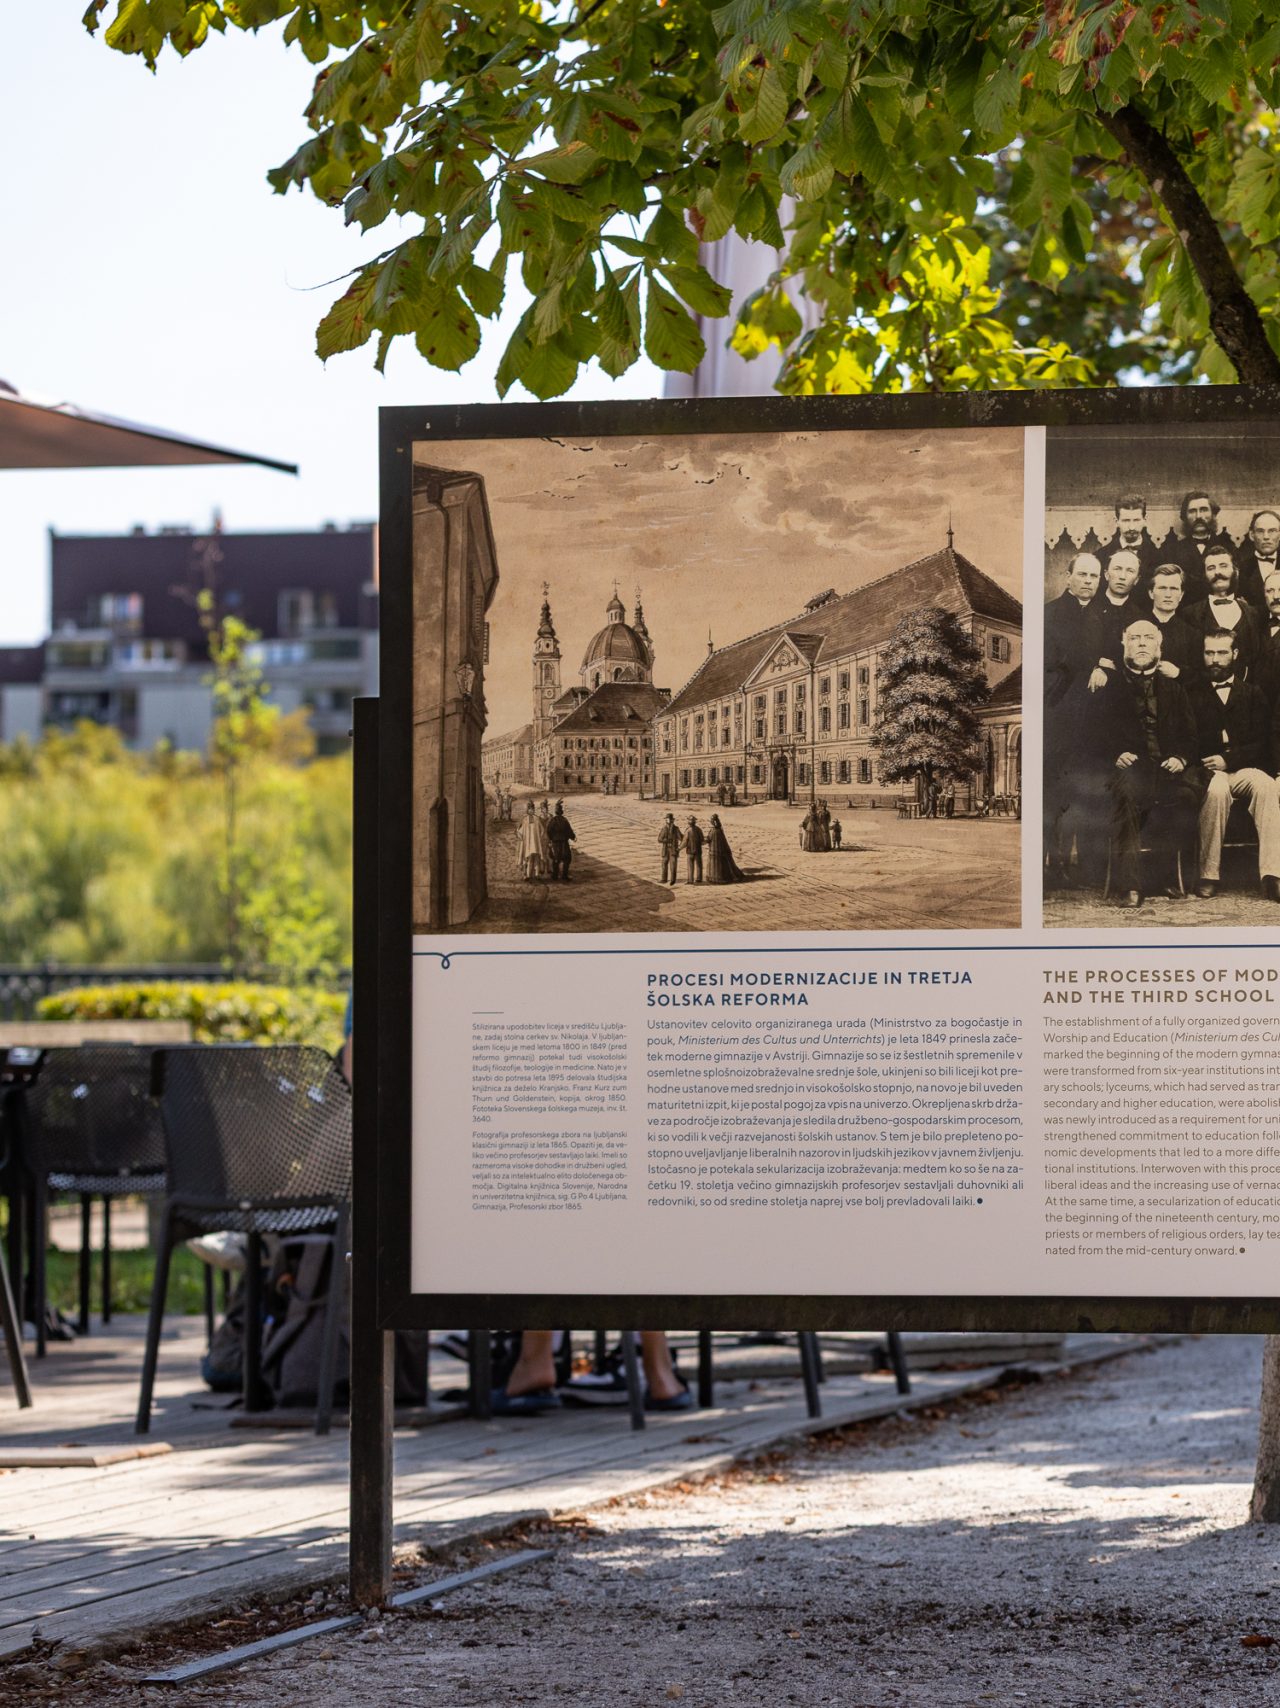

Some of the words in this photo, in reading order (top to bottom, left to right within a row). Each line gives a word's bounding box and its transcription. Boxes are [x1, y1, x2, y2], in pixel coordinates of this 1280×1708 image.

[648, 973, 723, 986] PROCESI
[730, 972, 877, 985] MODERNIZACIJE
[883, 971, 902, 984] IN
[907, 971, 972, 984] TRETJA
[1044, 970, 1078, 983] THE
[1085, 969, 1195, 982] PROCESSES
[1202, 969, 1227, 982] OF
[648, 990, 715, 1006] ŠOLSKA
[721, 993, 808, 1006] REFORMA
[1044, 991, 1082, 1003] AND
[1089, 990, 1124, 1003] THE
[1131, 990, 1188, 1003] THIRD
[1194, 989, 1274, 1002] SCHOOL
[647, 1019, 707, 1029] Ustanovitev
[711, 1019, 751, 1028] celovito
[755, 1018, 832, 1030] organiziranega
[835, 1017, 866, 1027] urada
[869, 1017, 931, 1029] (Ministrstvo
[935, 1019, 947, 1027] za
[950, 1017, 1009, 1029] bogočastje
[1012, 1017, 1024, 1026] in
[1044, 1016, 1064, 1026] The
[1064, 1016, 1140, 1026] establishment
[1141, 1015, 1153, 1025] of
[1162, 1015, 1185, 1028] fully
[1187, 1015, 1241, 1028] organized
[647, 1035, 674, 1047] pouk,
[678, 1035, 739, 1044] Ministerium
[741, 1035, 760, 1044] des
[762, 1034, 796, 1044] Cultus
[799, 1034, 820, 1044] und
[822, 1034, 885, 1046] Unterrichts)
[887, 1034, 896, 1046] je
[899, 1034, 919, 1043] leta
[921, 1033, 946, 1043] 1849
[948, 1033, 990, 1045] prinesla
[992, 1033, 1022, 1043] zače-
[1044, 1033, 1088, 1045] Worship
[1090, 1033, 1111, 1042] and
[1112, 1032, 1168, 1042] Education
[1170, 1032, 1238, 1044] (Ministerium
[1240, 1032, 1259, 1041] des
[1044, 1049, 1084, 1059] marked
[1086, 1049, 1104, 1059] the
[1106, 1049, 1160, 1061] beginning
[1162, 1048, 1173, 1059] of
[1175, 1048, 1193, 1058] the
[1195, 1048, 1238, 1058] modern
[672, 1115, 719, 1128] področje
[720, 1115, 791, 1127] izobraževanja
[792, 1117, 801, 1127] je
[803, 1115, 836, 1125] sledila
[837, 1115, 966, 1127] družbeno-gospodarskim
[967, 1116, 1023, 1126] procesom,
[1044, 1130, 1117, 1143] strengthened
[1119, 1130, 1188, 1141] commitment
[1191, 1131, 1202, 1140] to
[1204, 1130, 1259, 1140] education
[647, 1180, 676, 1189] četku
[680, 1179, 692, 1189] 19.
[696, 1180, 733, 1192] stoletja
[737, 1180, 771, 1190] večino
[774, 1180, 838, 1192] gimnazijskih
[841, 1179, 900, 1192] profesorjev
[903, 1179, 953, 1192] sestavljali
[956, 1179, 1009, 1189] duhovniki
[1011, 1179, 1024, 1189] ali
[647, 1196, 697, 1206] redovniki,
[713, 1196, 727, 1205] od
[729, 1196, 768, 1205] sredine
[770, 1197, 808, 1208] stoletja
[809, 1198, 843, 1208] naprej
[864, 1196, 884, 1208] bolj
[886, 1196, 950, 1207] prevladovali
[951, 1196, 976, 1205] laiki.
